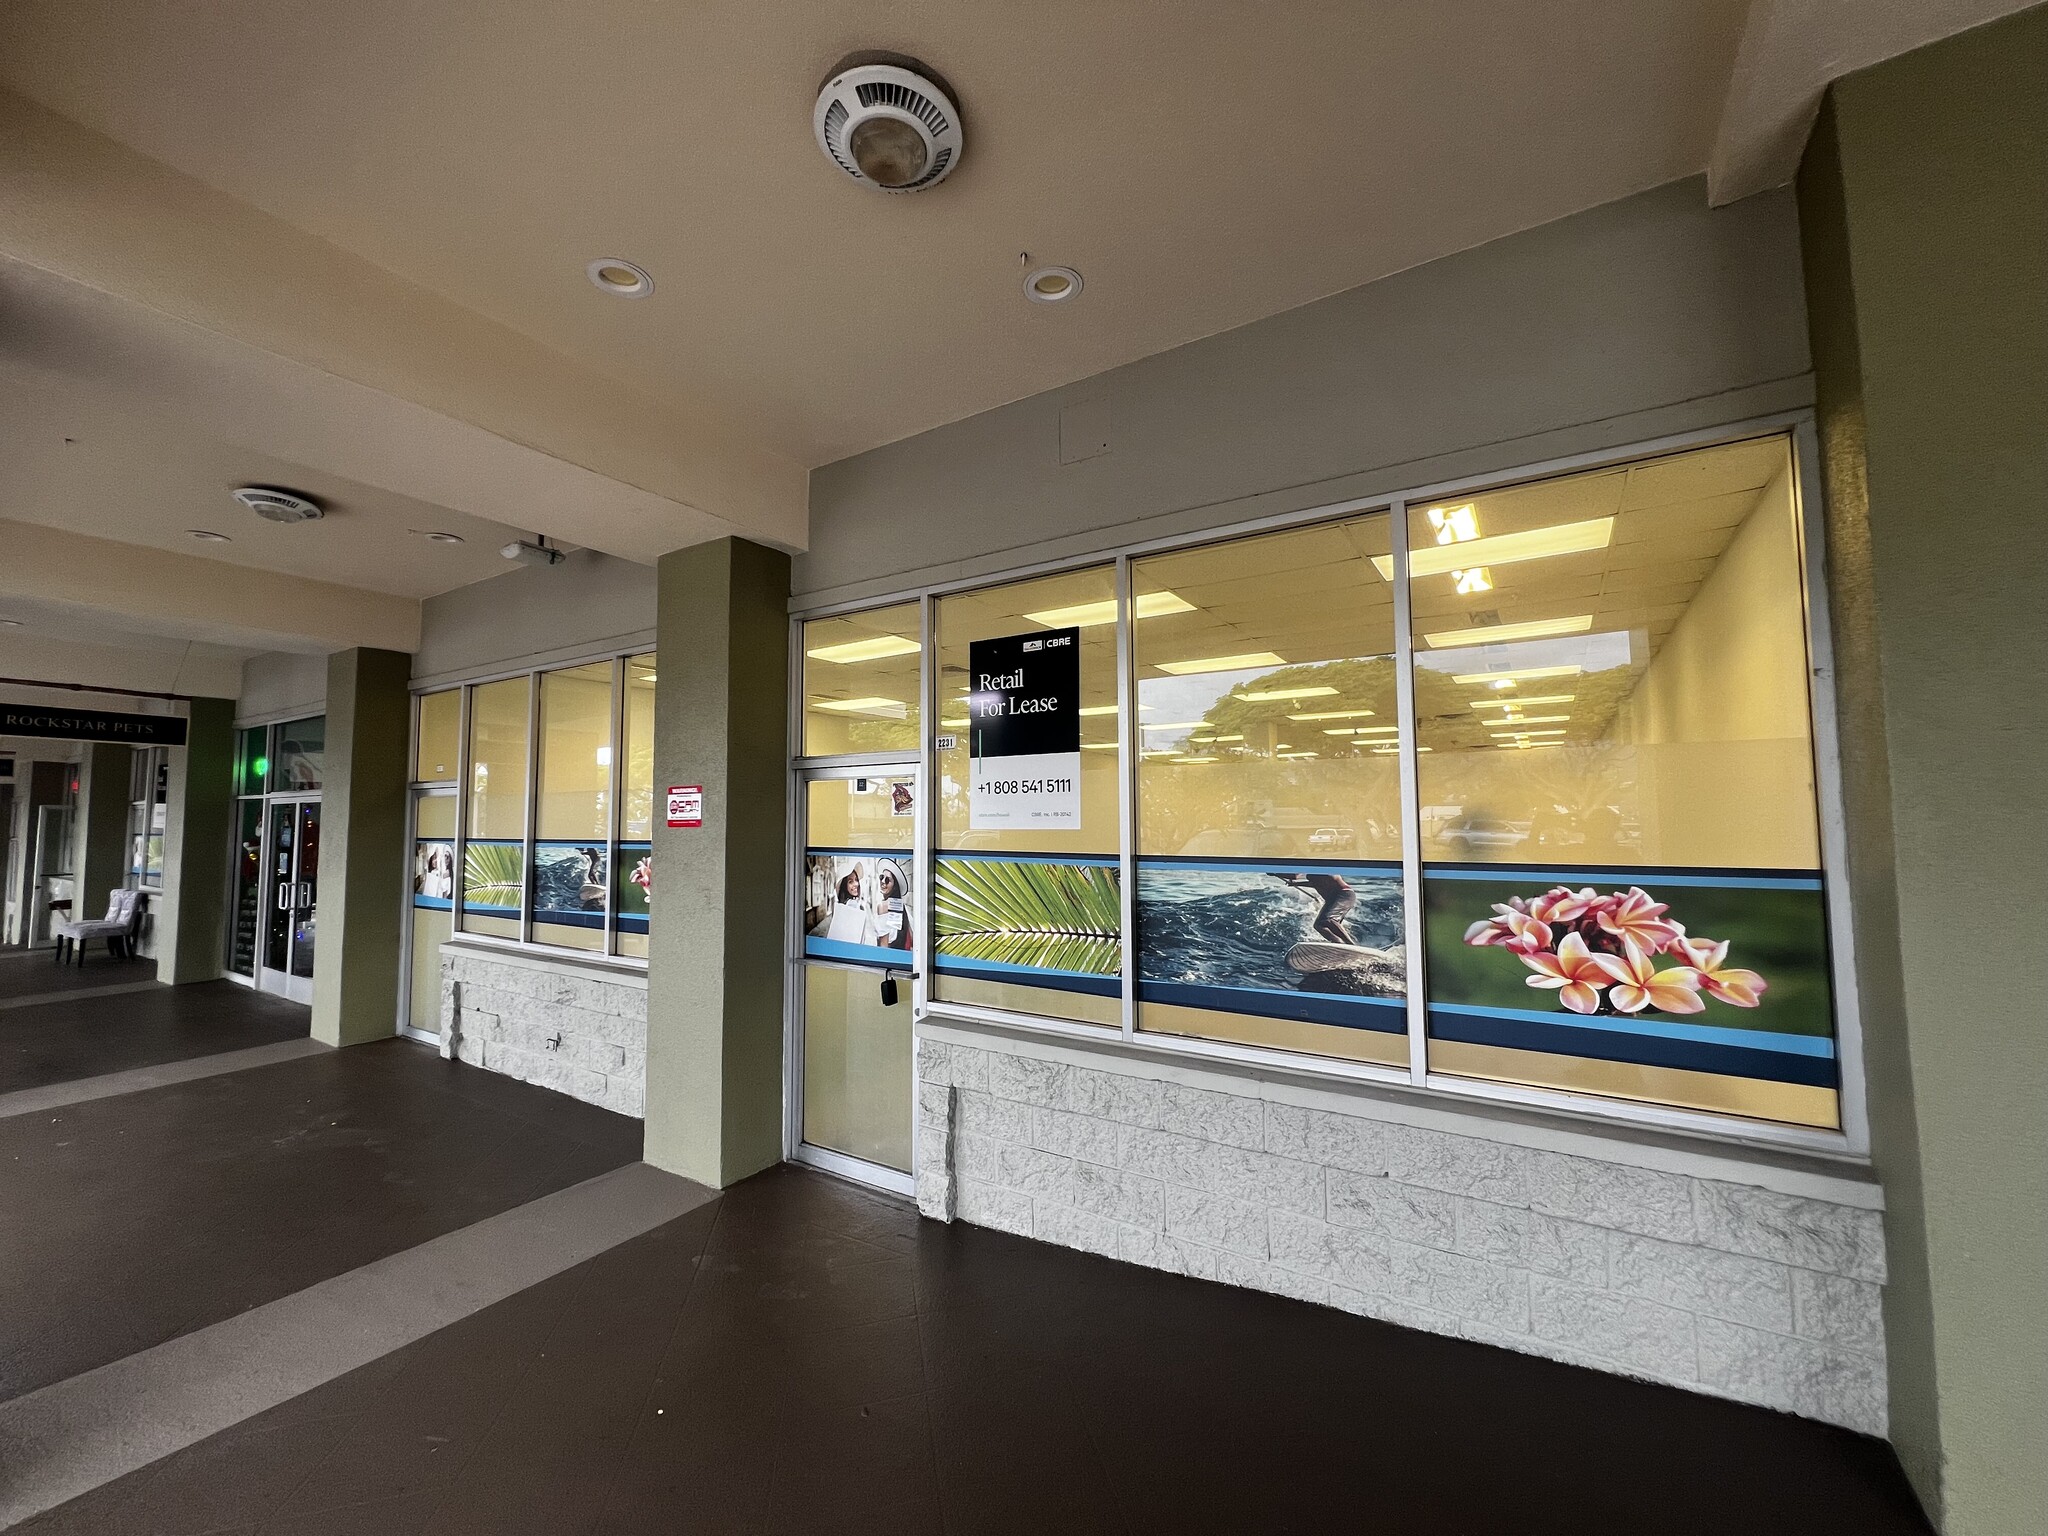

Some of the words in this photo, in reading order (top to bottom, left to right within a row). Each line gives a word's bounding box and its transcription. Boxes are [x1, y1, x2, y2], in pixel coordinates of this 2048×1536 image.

[1046, 637, 1071, 648] CBRE
[979, 668, 1024, 692] Retail
[979, 699, 1006, 718] For
[1008, 696, 1058, 715] Lease
[6, 714, 107, 731] ROCKSTAR
[114, 722, 154, 734] PETS
[938, 738, 953, 748] 2231
[978, 781, 991, 794] +1
[994, 780, 1018, 795] 808
[1021, 779, 1043, 794] 541
[1046, 778, 1071, 793] 5111
